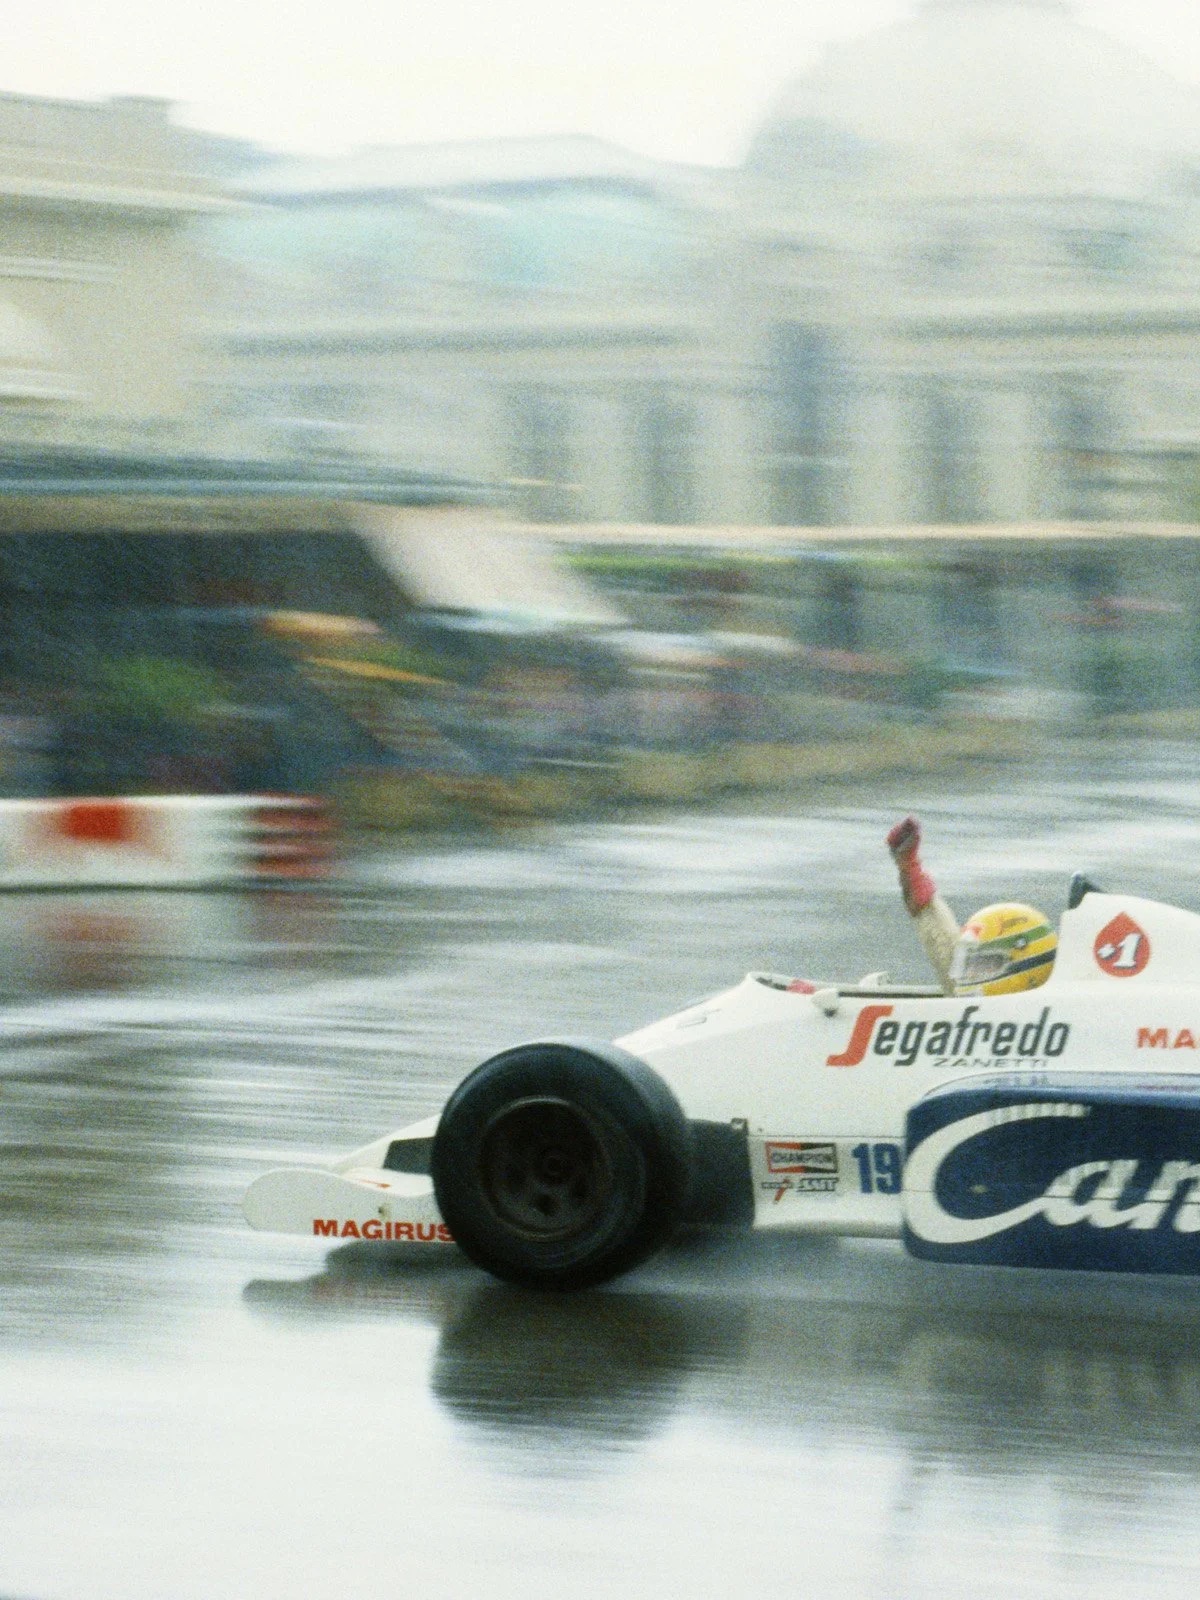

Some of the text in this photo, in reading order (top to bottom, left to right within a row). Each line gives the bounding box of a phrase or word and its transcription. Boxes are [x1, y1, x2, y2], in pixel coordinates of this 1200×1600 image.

[826, 1004, 1071, 1067] Segafredo
[932, 1057, 1048, 1068] ZANETTI
[770, 1151, 833, 1164] CHAMPION
[851, 1142, 904, 1195] 19
[313, 1219, 457, 1242] MAGIRUS
